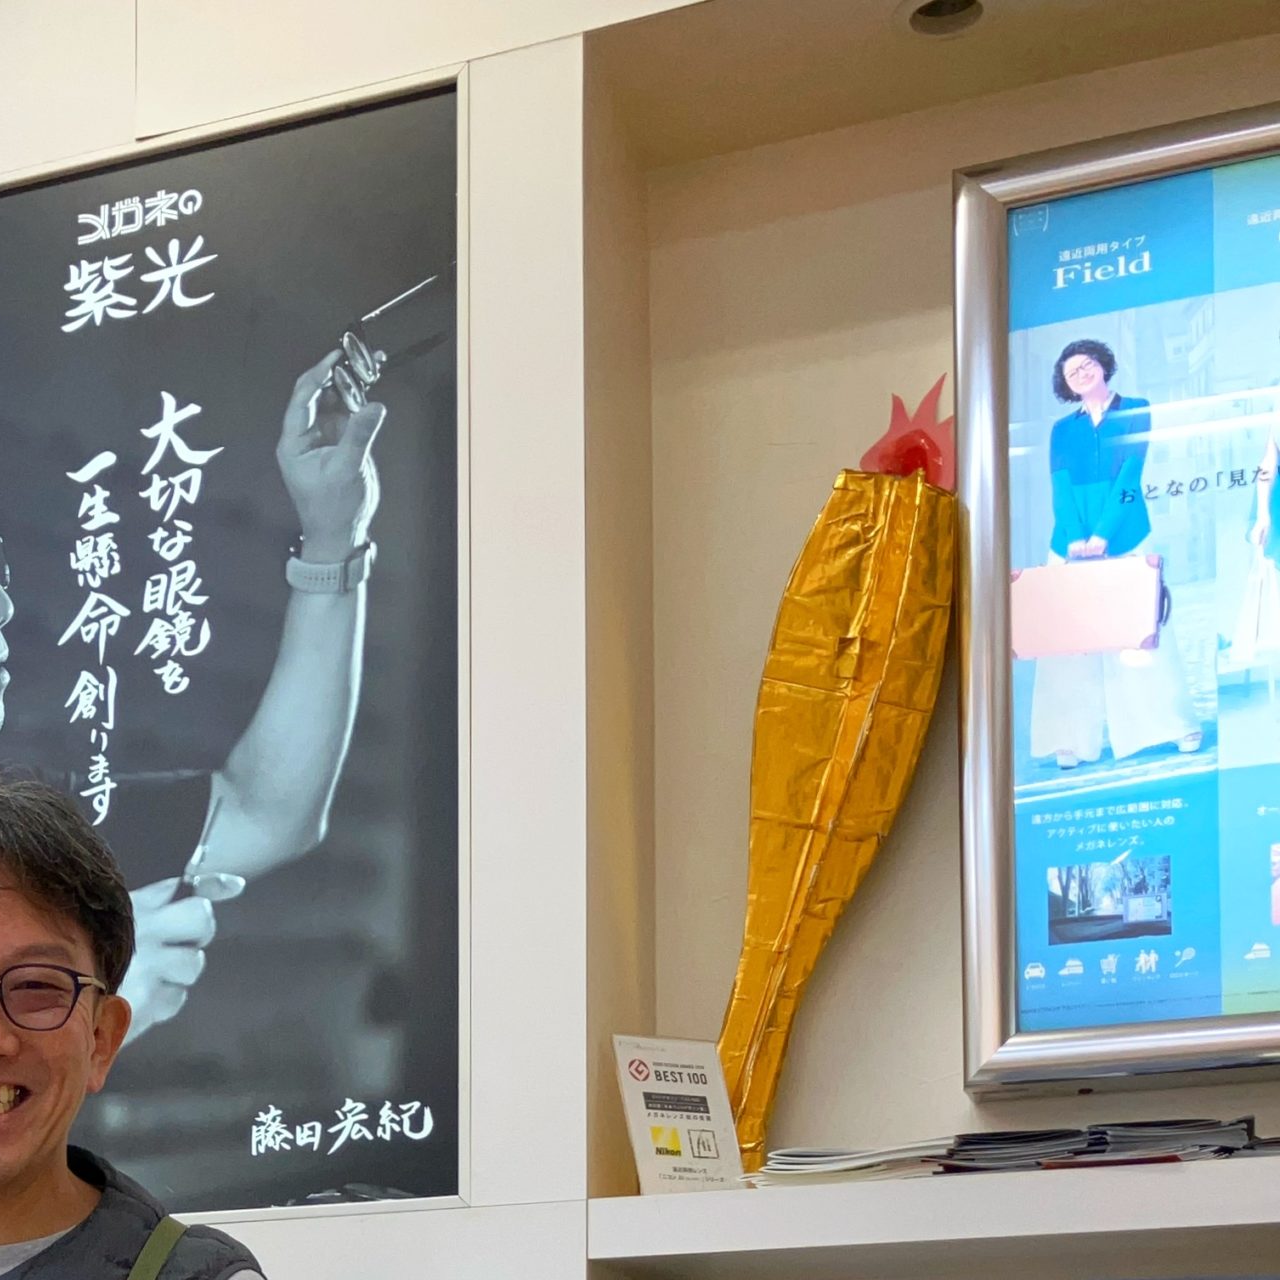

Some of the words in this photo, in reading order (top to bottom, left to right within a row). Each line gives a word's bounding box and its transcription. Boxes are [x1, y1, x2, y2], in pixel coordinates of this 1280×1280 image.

[77, 188, 203, 246] メガネの
[1058, 234, 1147, 262] 遠近両用タイプ
[61, 234, 218, 333] 紫光
[1051, 250, 1153, 290] Field
[1120, 464, 1280, 504] おとなの「見た
[134, 390, 224, 695] 大切な眼鏡を
[654, 1070, 683, 1083] BEST
[687, 1073, 708, 1085] 100
[656, 1147, 681, 1157] Nikon
